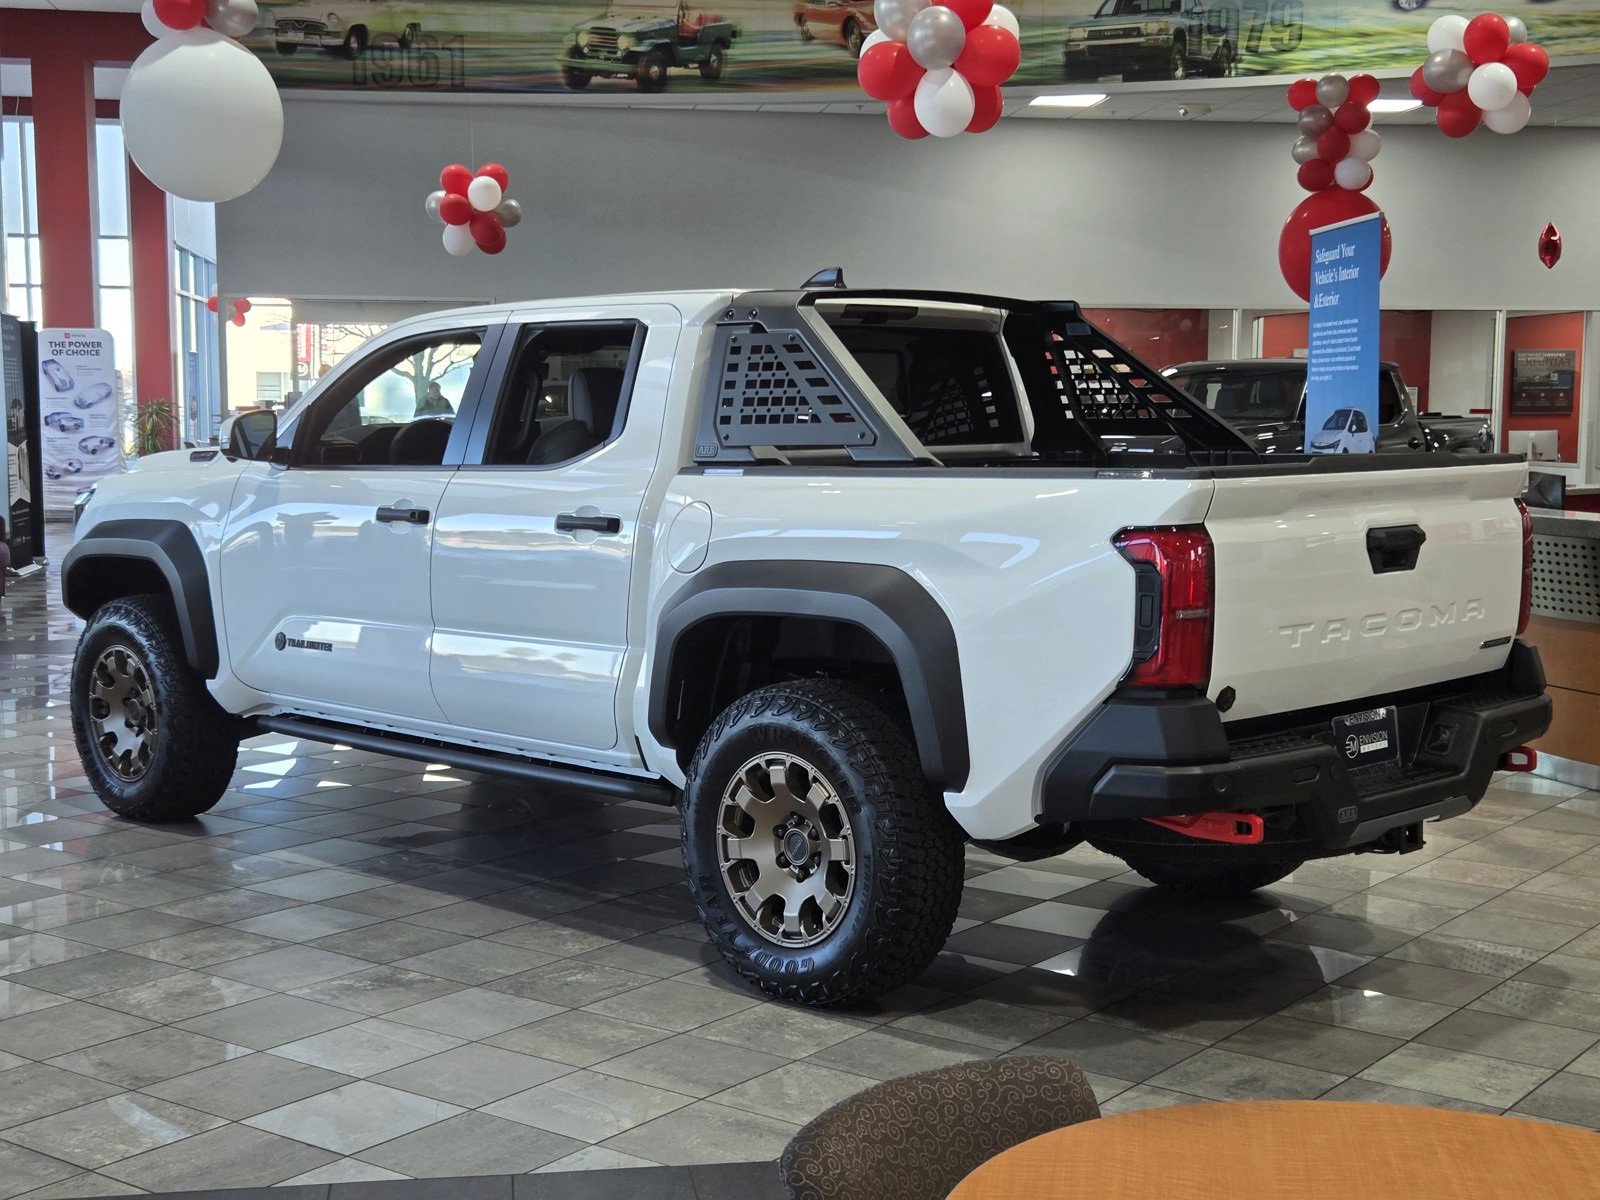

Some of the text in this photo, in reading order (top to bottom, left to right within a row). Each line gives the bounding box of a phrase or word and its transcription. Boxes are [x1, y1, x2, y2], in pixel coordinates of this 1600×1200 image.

[352, 32, 465, 88] 1961
[1315, 243, 1355, 265] Safeguard Your
[1314, 264, 1360, 285] Vehicle's Interior
[48, 341, 103, 349] THE POWER
[51, 349, 101, 357] OF CHOICE
[698, 445, 716, 455] ARB
[1278, 598, 1485, 649] TACOMA
[287, 638, 333, 652] TRAILHUNTER
[1359, 730, 1388, 746] ENVISION
